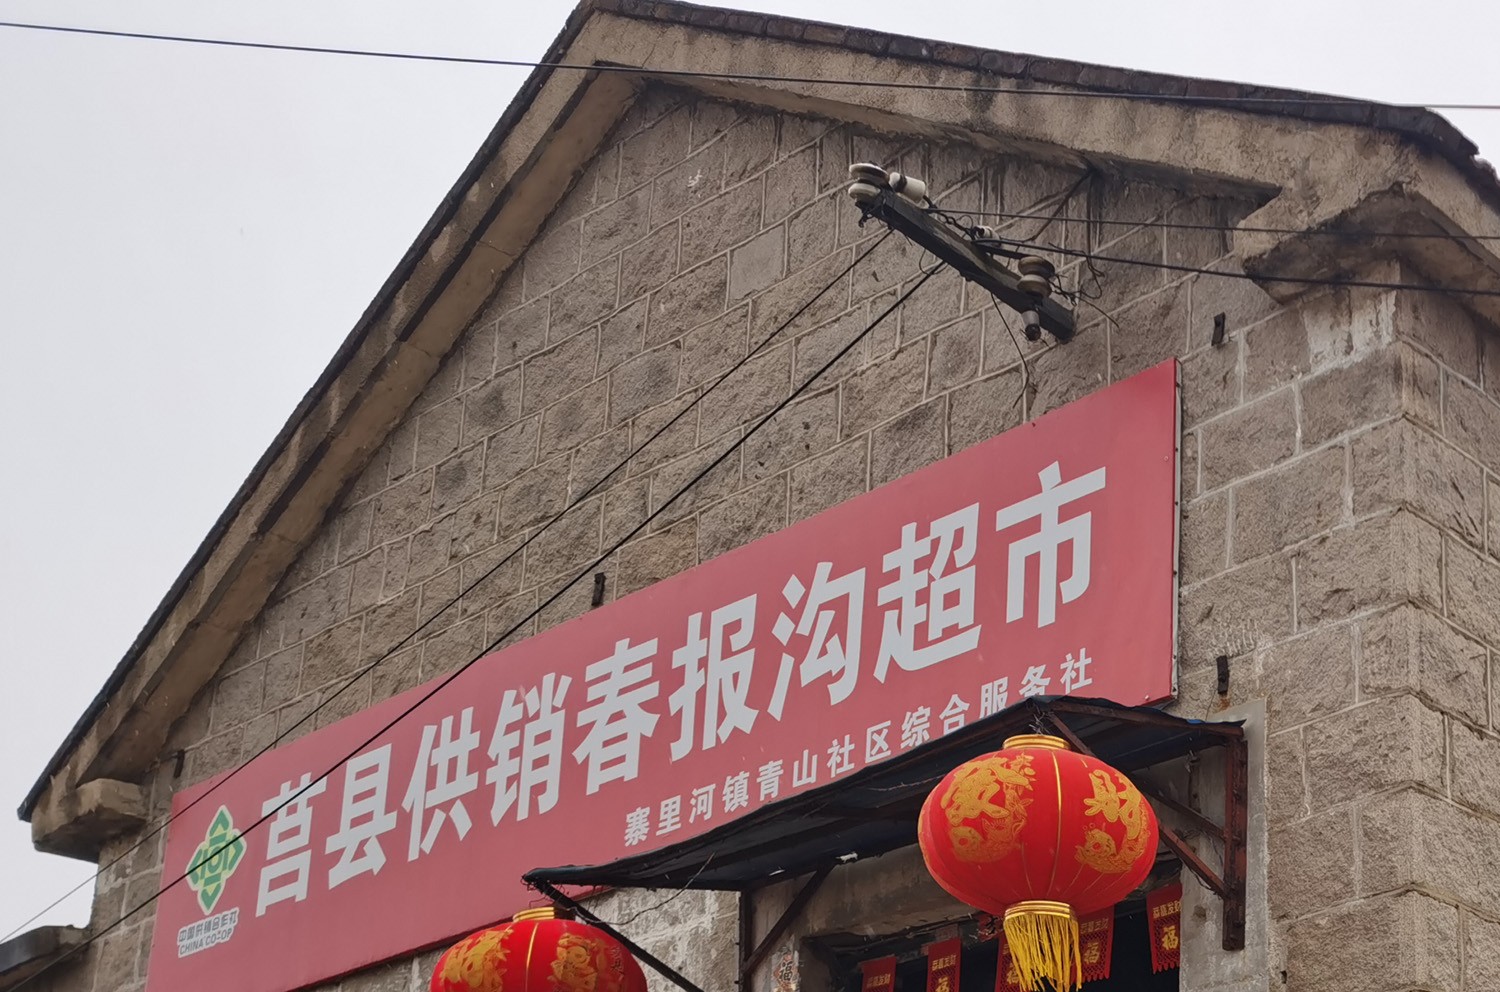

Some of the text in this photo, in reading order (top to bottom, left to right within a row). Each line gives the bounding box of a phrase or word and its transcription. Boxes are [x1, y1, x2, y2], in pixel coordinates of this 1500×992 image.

[255, 460, 1106, 916] 莒县供销春报沟超市
[624, 647, 1093, 847] 寨里河镇青山社区综合服务社
[180, 938, 204, 956] CHINA
[1161, 925, 1179, 951] 福
[1084, 942, 1100, 964] 福
